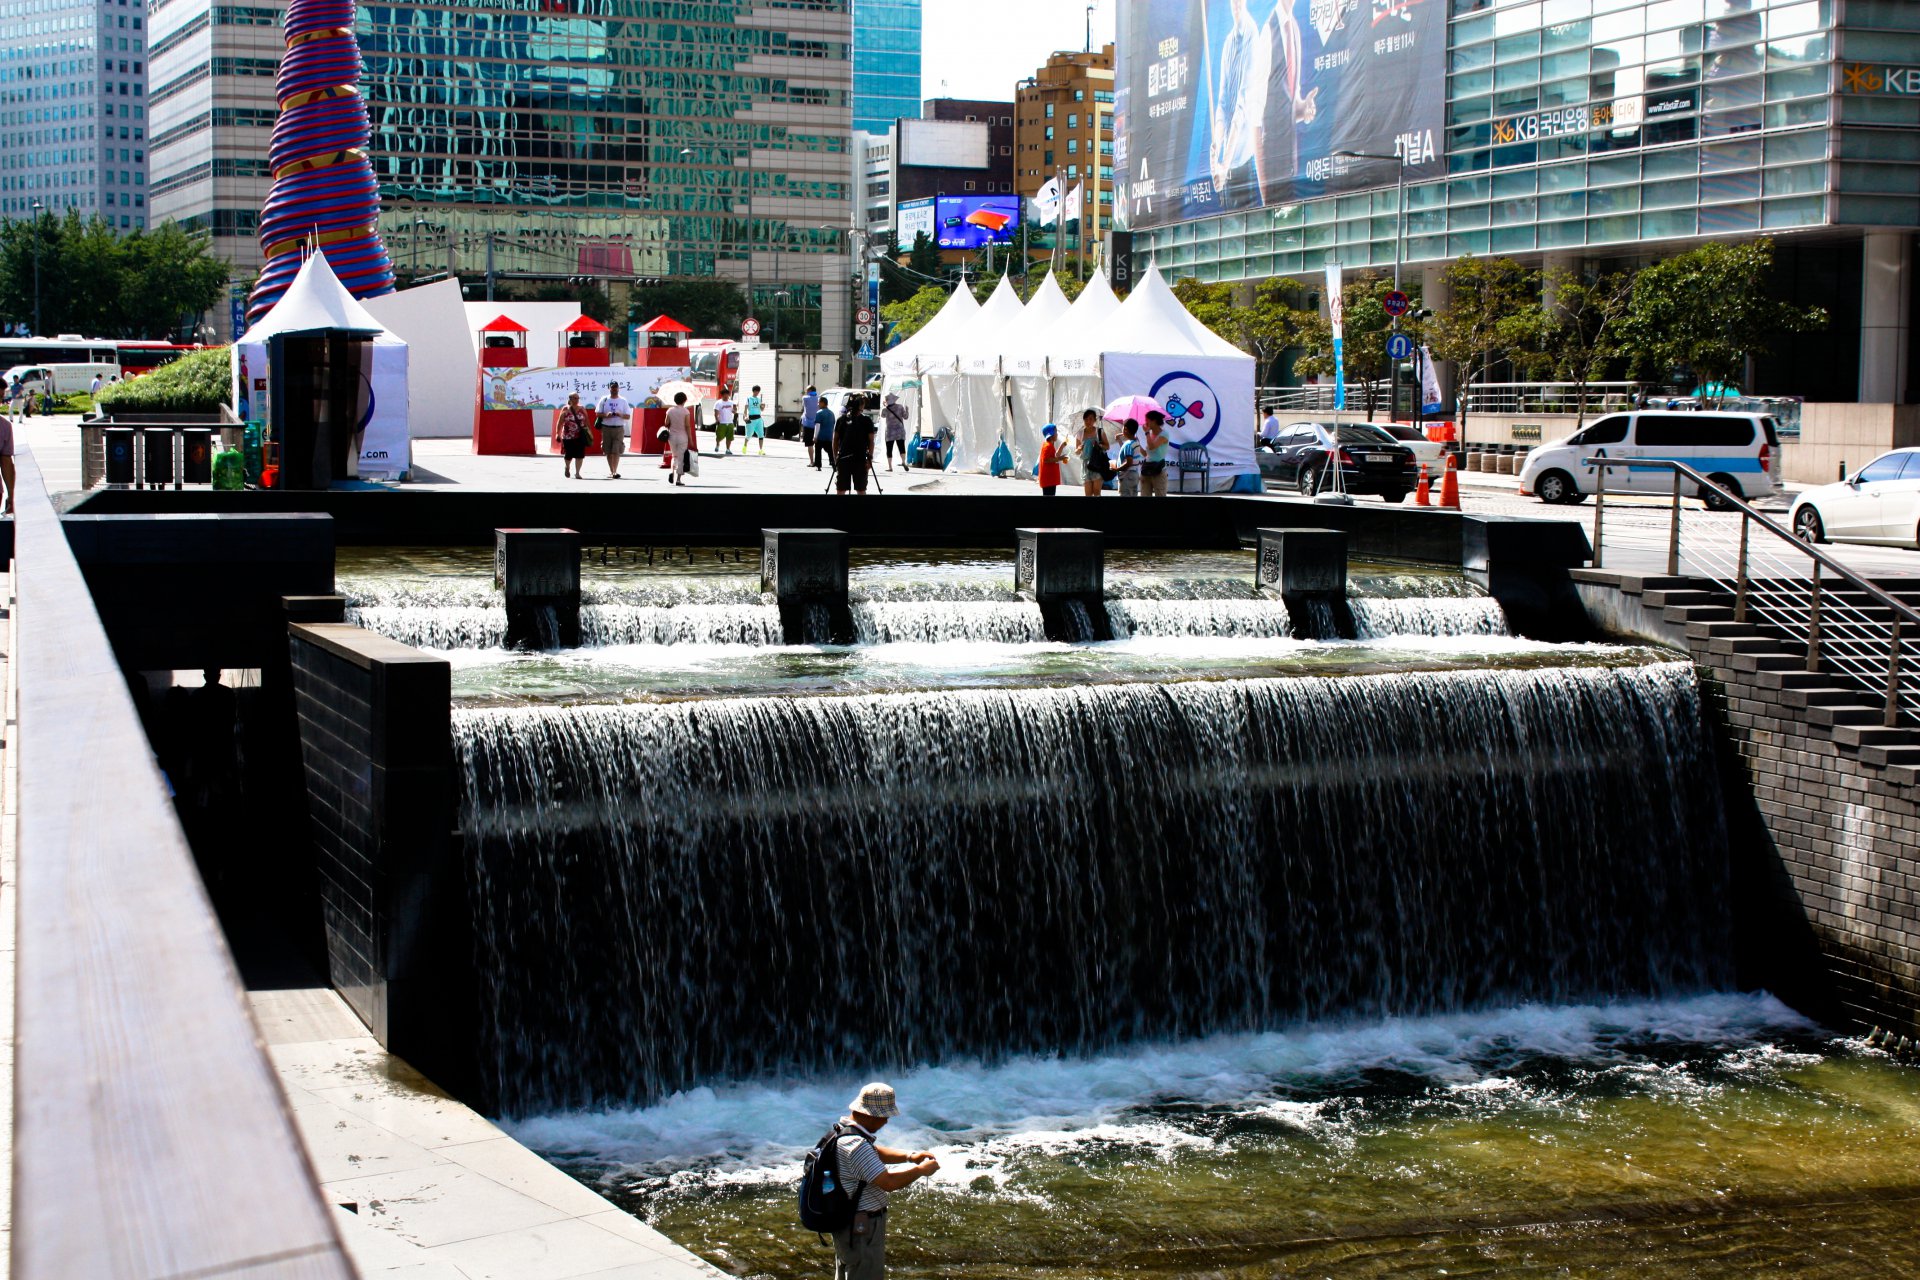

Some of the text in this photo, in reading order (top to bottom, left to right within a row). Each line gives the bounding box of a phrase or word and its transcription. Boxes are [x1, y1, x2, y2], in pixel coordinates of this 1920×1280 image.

[1885, 68, 1920, 93] KB
[1394, 129, 1435, 167] 채널A
[1306, 158, 1331, 181] 이영돈
[1132, 179, 1156, 199] CHANNEL
[1192, 181, 1212, 203] 박종진
[860, 313, 868, 321] 30
[573, 378, 597, 394] 즐거운
